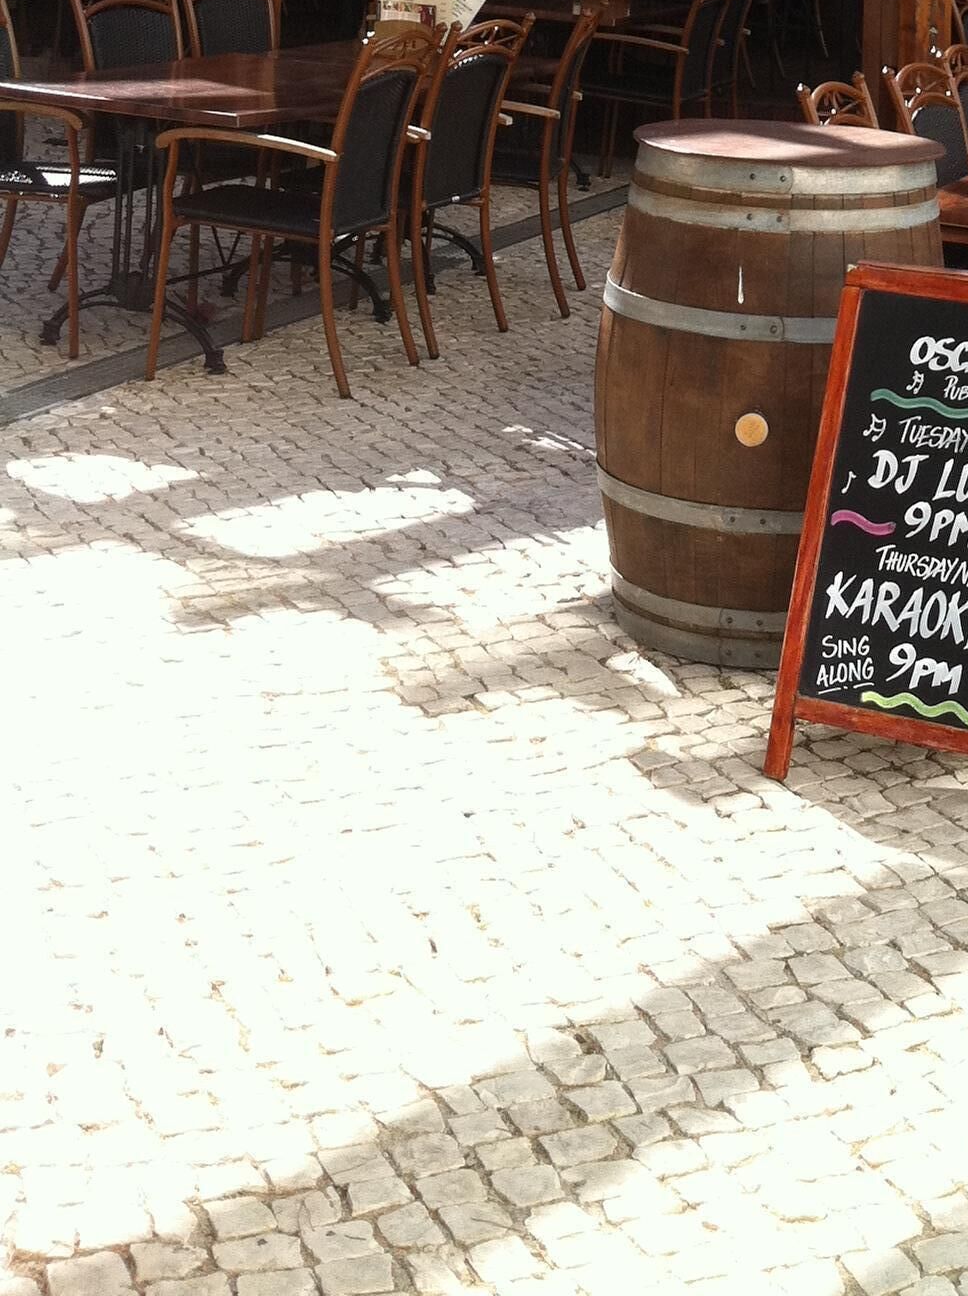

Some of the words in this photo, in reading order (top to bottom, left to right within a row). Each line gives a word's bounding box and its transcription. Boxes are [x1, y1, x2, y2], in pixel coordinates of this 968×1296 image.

[868, 449, 930, 495] DJ
[875, 544, 961, 583] THURSDAY
[821, 635, 871, 659] SING
[816, 657, 875, 688] ALONG
